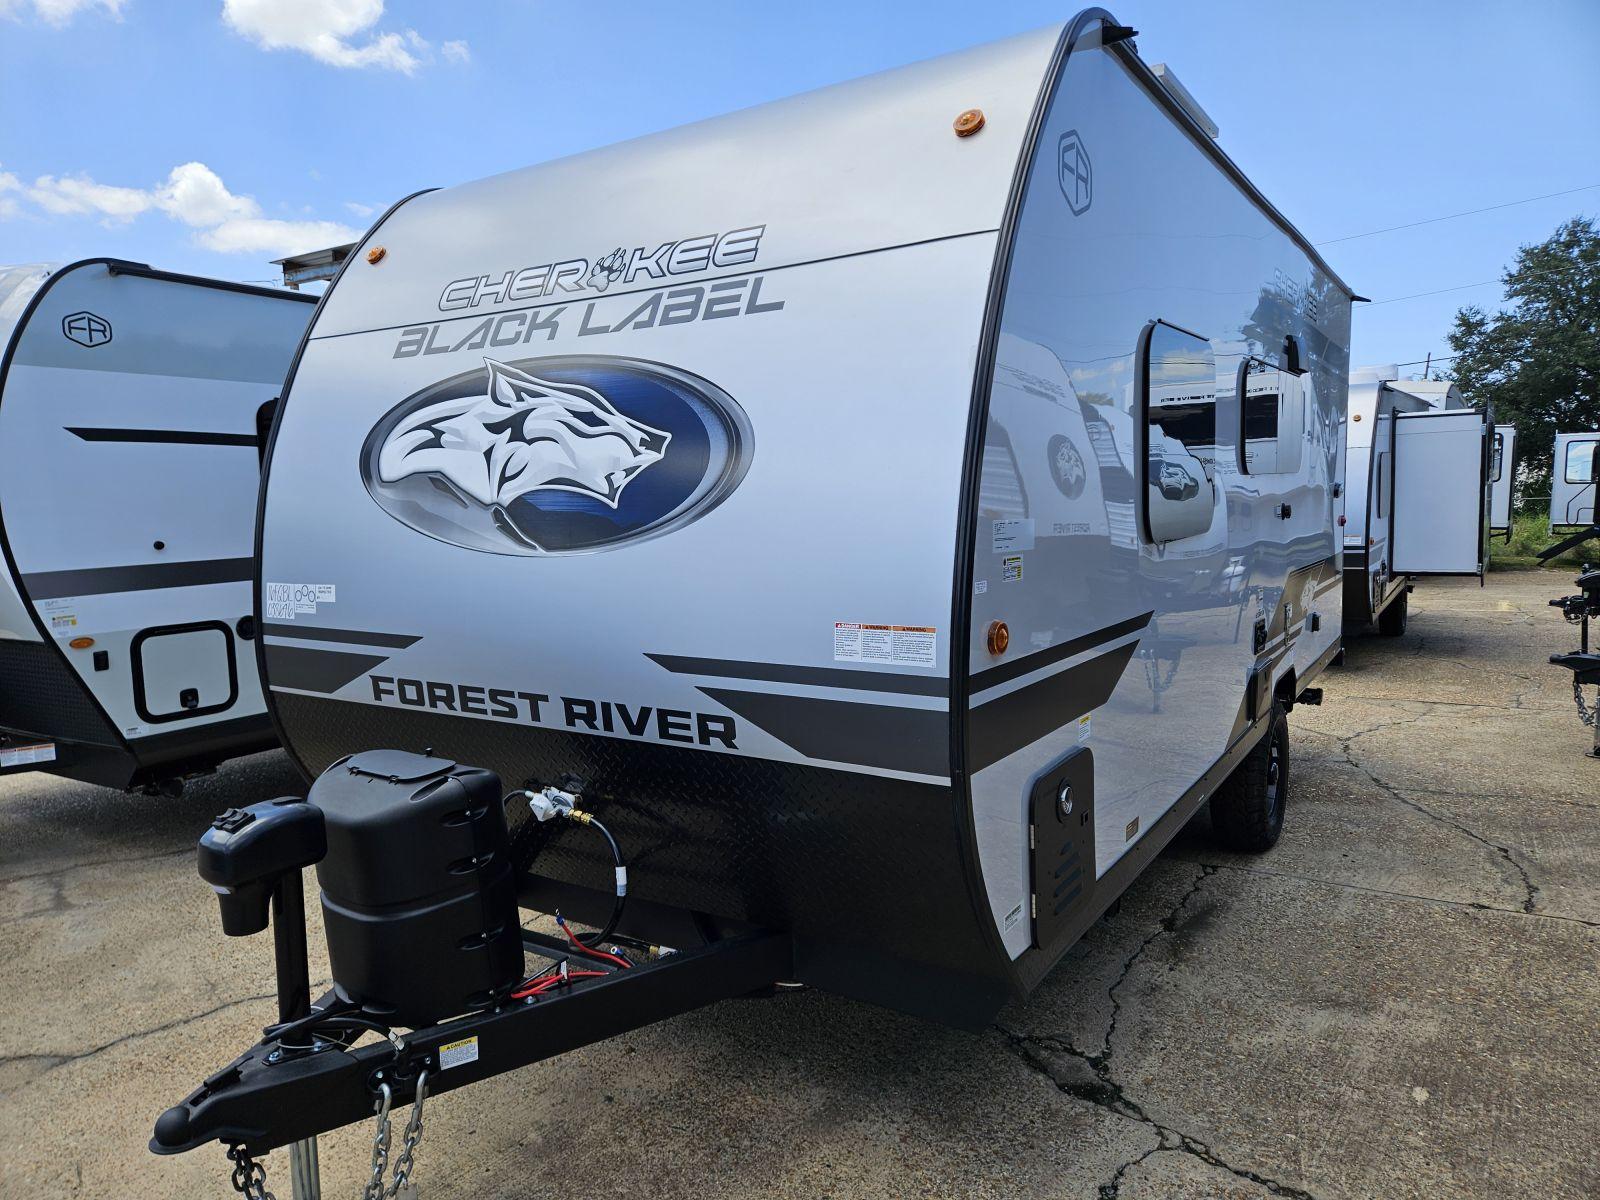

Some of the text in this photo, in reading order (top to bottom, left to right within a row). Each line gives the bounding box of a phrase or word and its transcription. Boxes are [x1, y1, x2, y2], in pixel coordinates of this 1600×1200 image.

[392, 276, 786, 360] BLACK LABEL
[369, 674, 740, 751] FOREST RIVER
[451, 1039, 472, 1049] CAUTION
